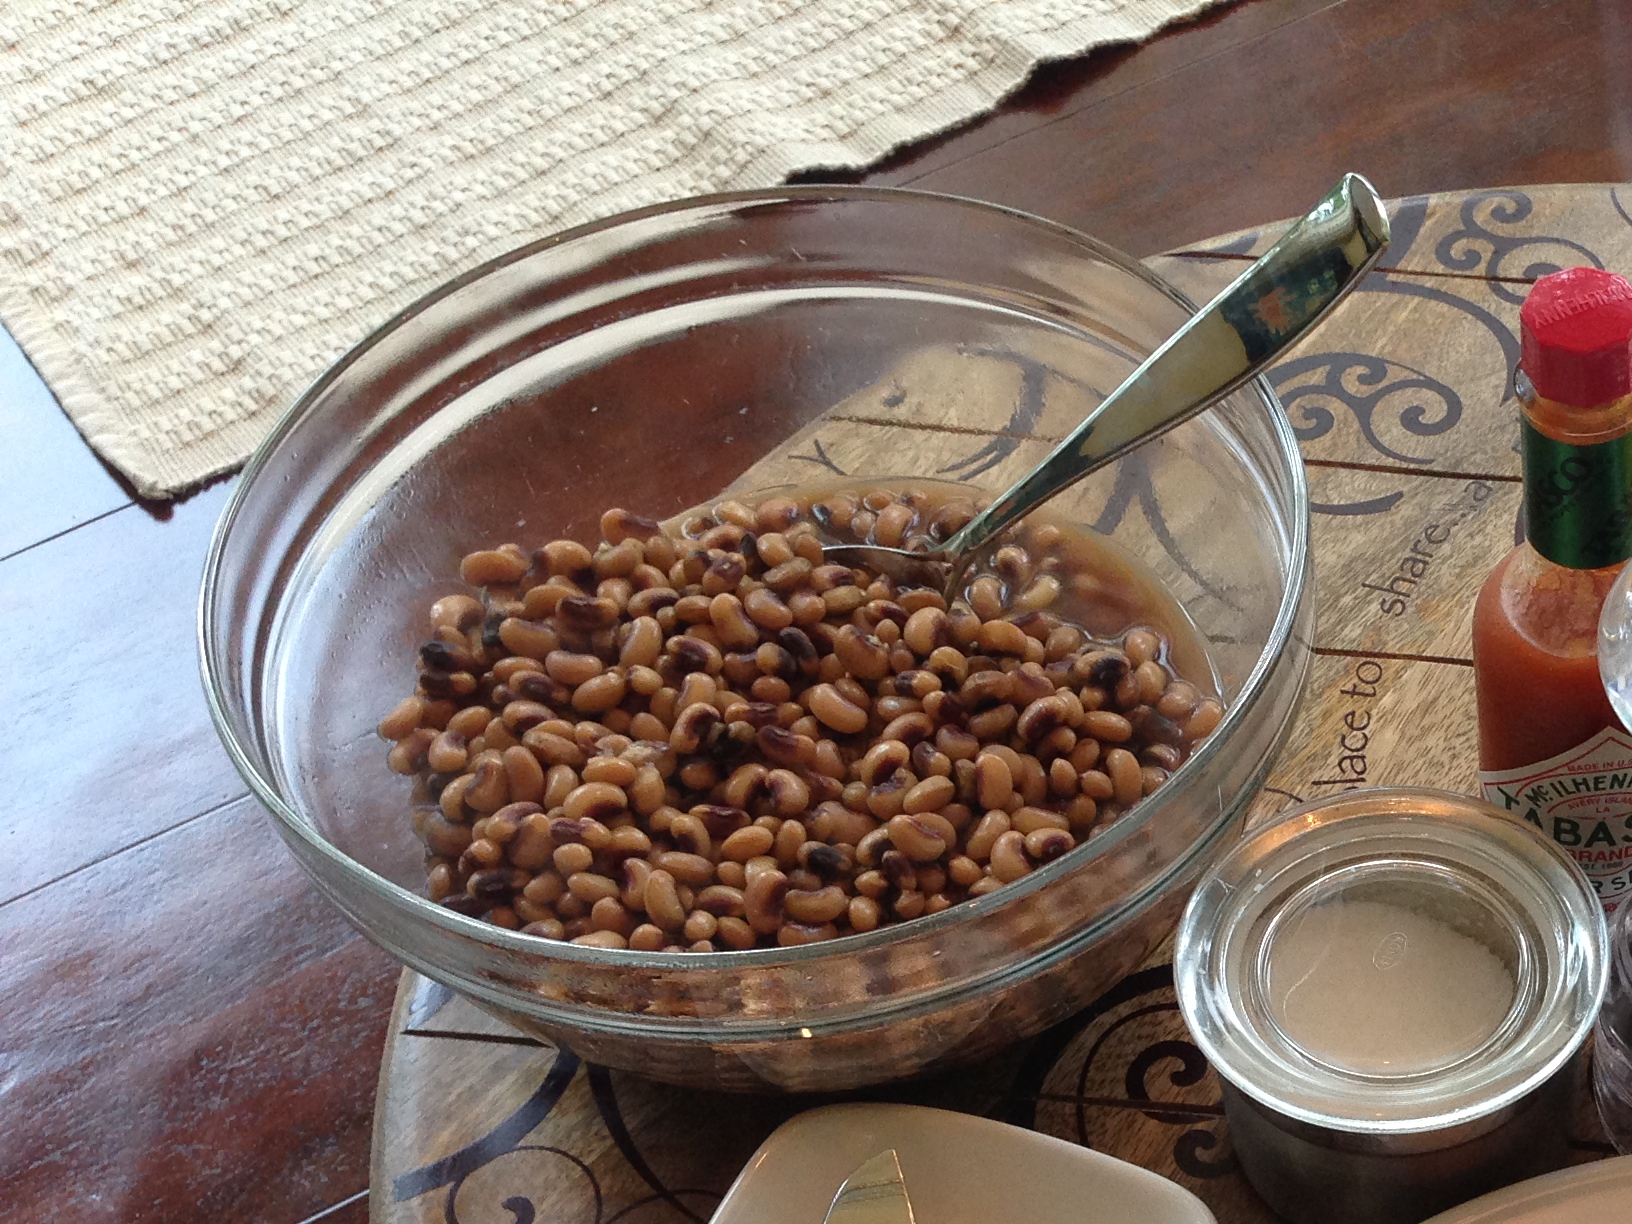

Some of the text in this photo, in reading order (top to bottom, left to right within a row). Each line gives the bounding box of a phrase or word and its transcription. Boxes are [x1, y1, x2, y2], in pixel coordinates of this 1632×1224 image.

[1339, 660, 1383, 700] to
[1311, 709, 1371, 790] lace
[1566, 763, 1599, 772] MADE
[1602, 761, 1614, 769] IN
